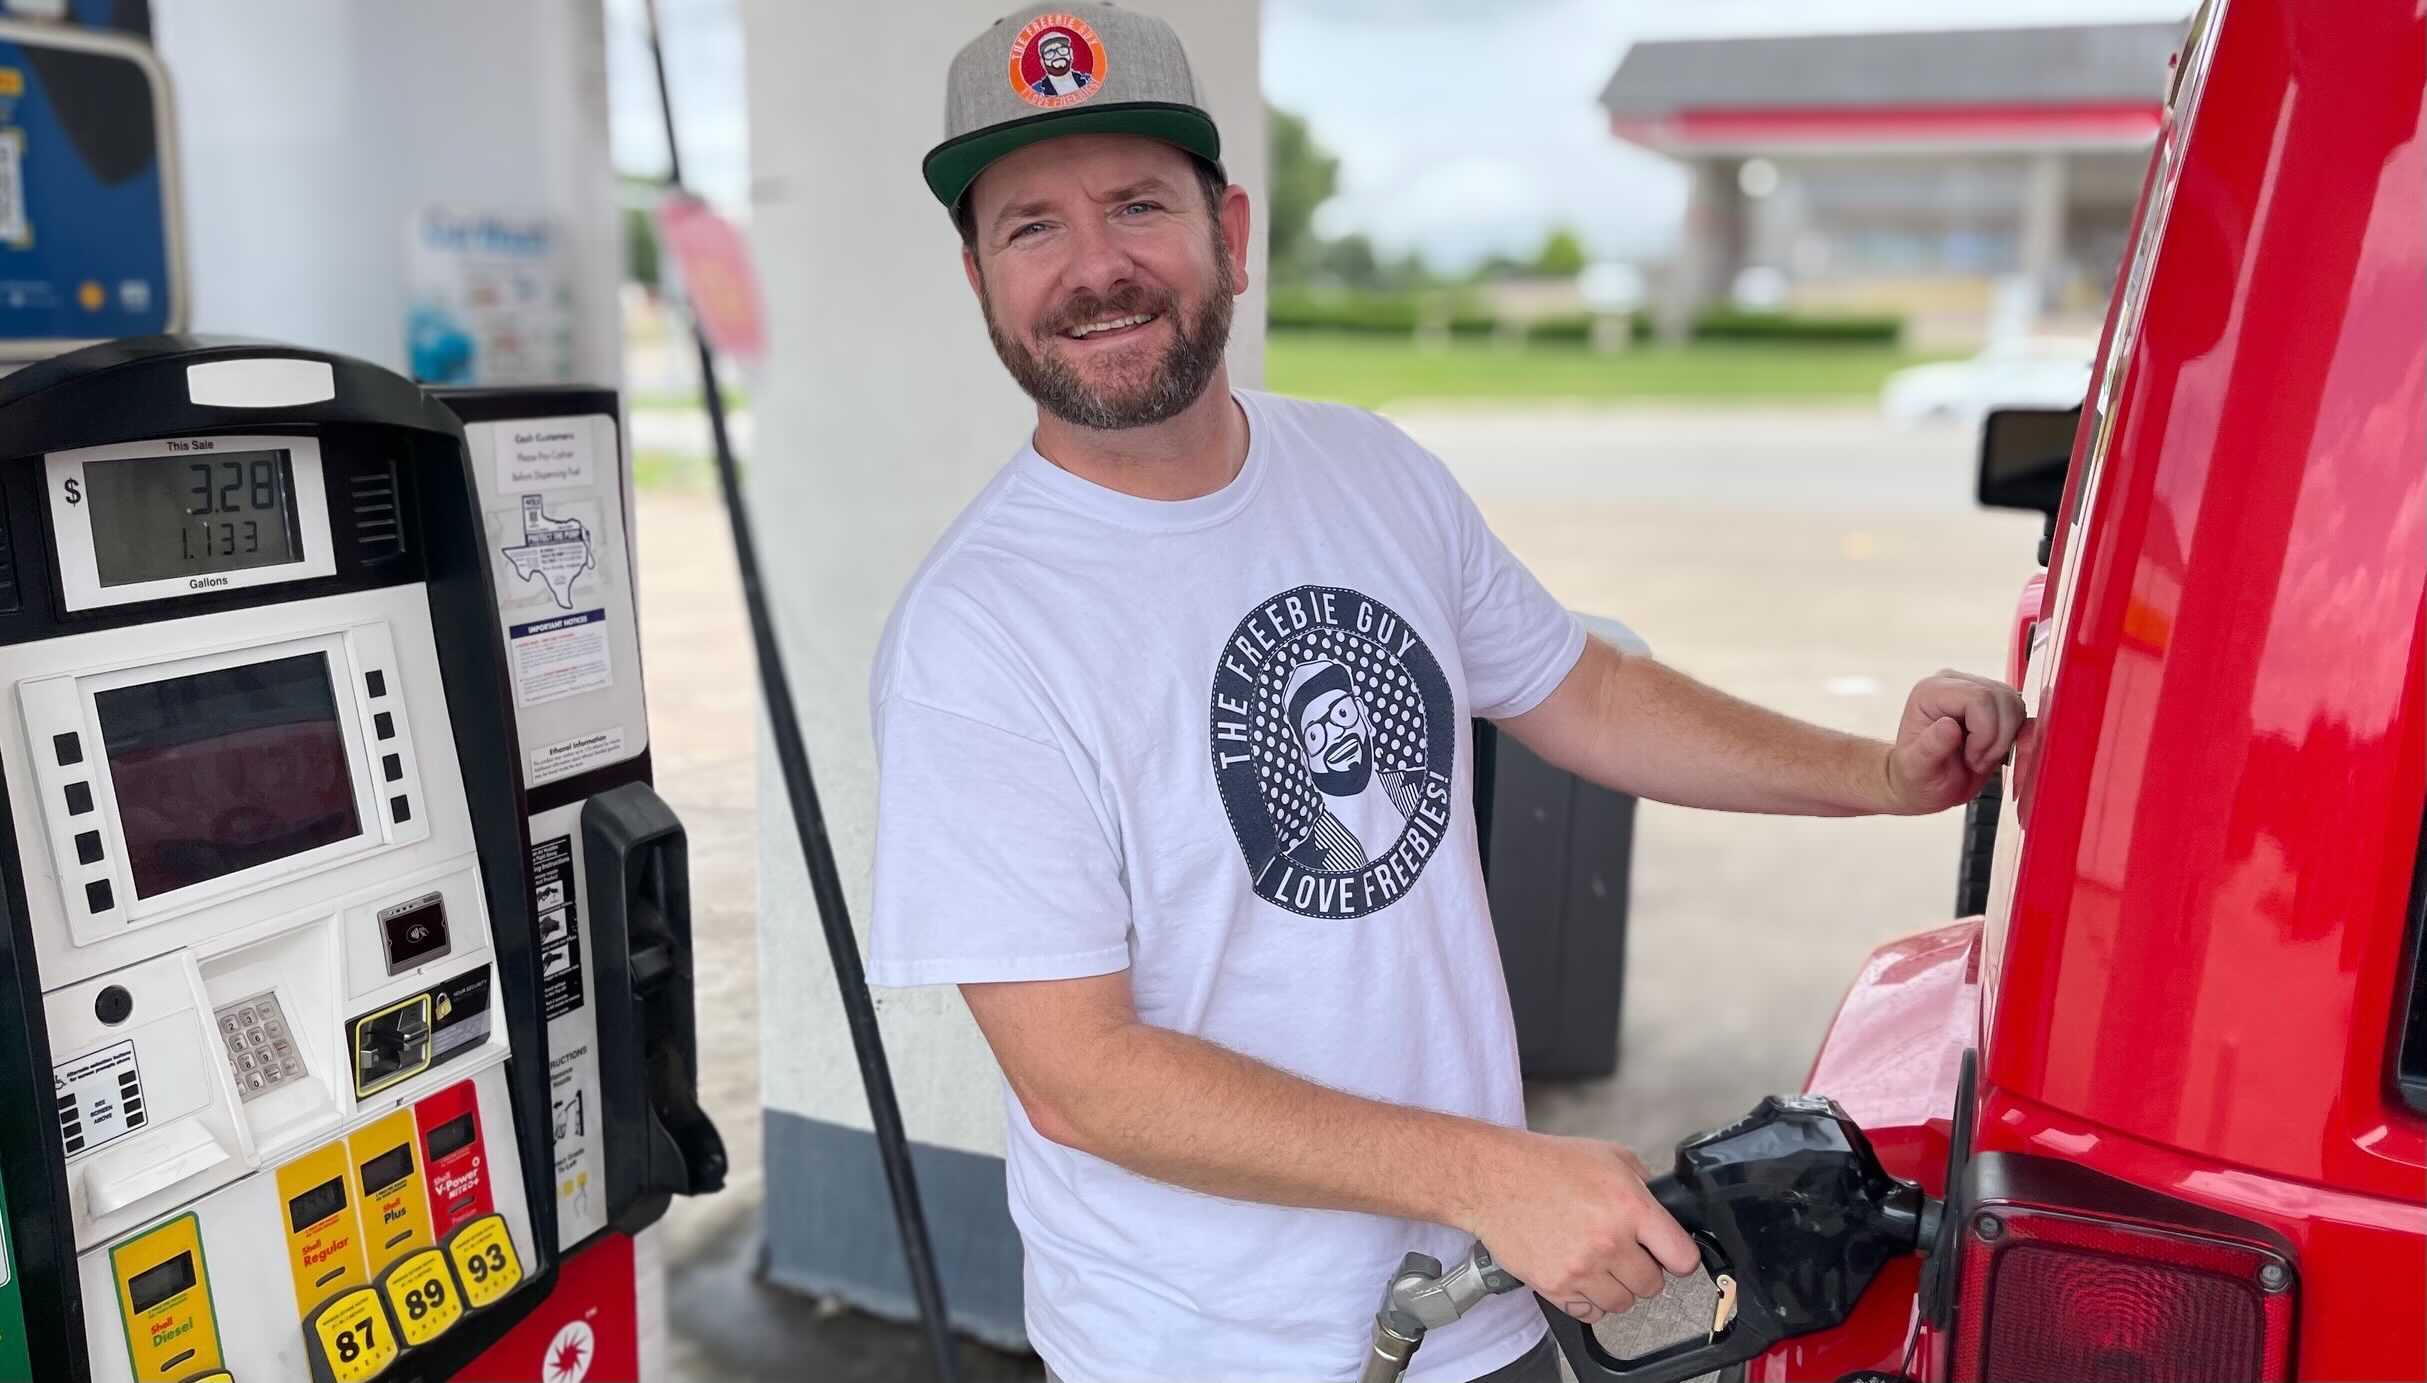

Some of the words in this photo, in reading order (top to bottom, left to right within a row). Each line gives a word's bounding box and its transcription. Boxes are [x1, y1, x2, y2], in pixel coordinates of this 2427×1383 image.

[167, 441, 190, 452] This
[191, 440, 214, 451] Sale
[64, 477, 82, 508] $
[190, 460, 274, 516] 3.28
[181, 521, 258, 560] 1.133
[189, 575, 228, 590] Gallons
[528, 618, 562, 634] IMPORTANT
[564, 615, 587, 629] NOTICES
[1225, 590, 1339, 683] FREEBIE
[1356, 601, 1418, 658] GUY
[573, 735, 607, 749] Information
[1217, 693, 1251, 769] THE
[1255, 856, 1276, 886] I
[1274, 866, 1355, 913] LOVE
[1362, 769, 1450, 908] FREEBIES!
[433, 1171, 451, 1186] Shell
[435, 1167, 479, 1196] V-Power
[383, 1197, 401, 1212] Shell
[384, 1207, 407, 1224] Plus
[302, 1239, 322, 1255] Shell
[303, 1237, 349, 1268] Regular
[467, 1243, 506, 1284] 93
[405, 1278, 445, 1321] 89
[151, 1316, 174, 1336] Shell
[153, 1316, 194, 1347] Diesel
[336, 1315, 375, 1363] 87
